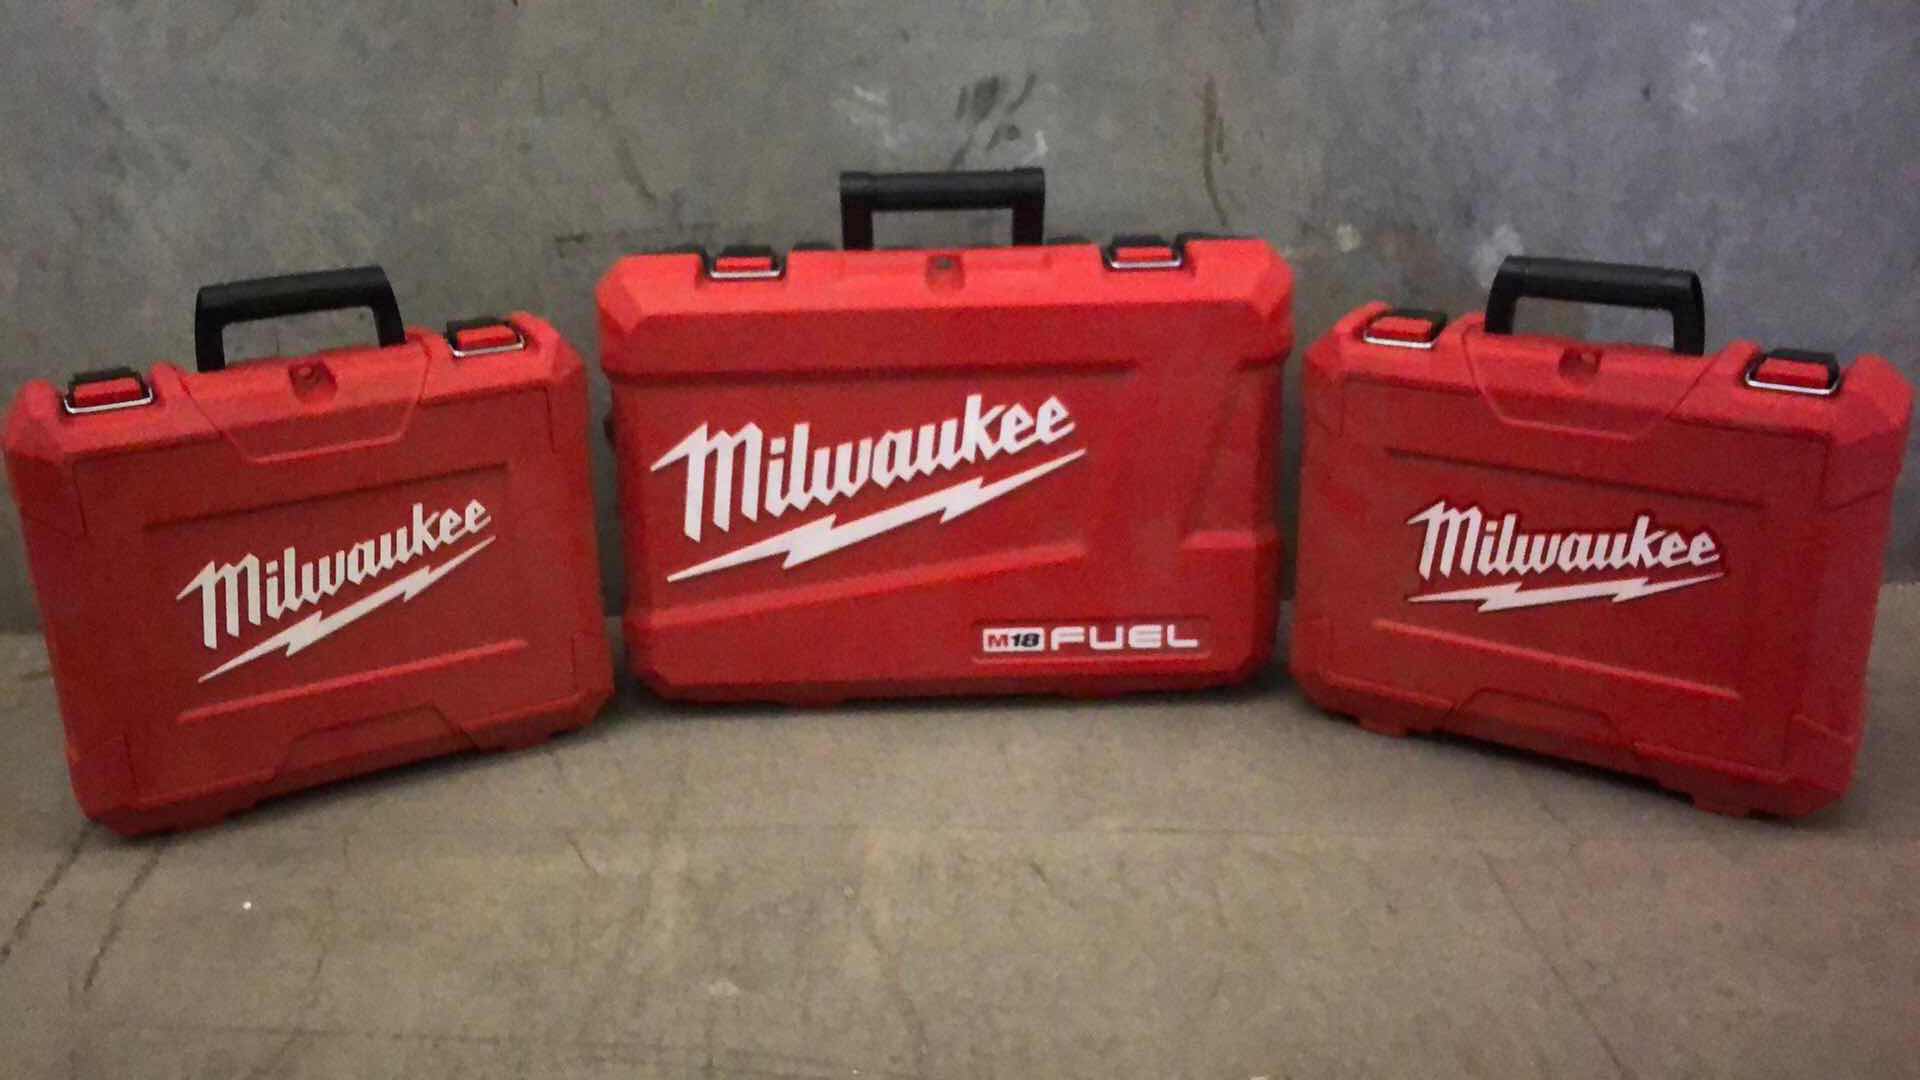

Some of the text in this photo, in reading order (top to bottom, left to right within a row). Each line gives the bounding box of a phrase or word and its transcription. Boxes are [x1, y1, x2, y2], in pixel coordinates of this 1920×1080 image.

[650, 393, 1076, 543] Milwaukee
[176, 499, 492, 649] Milwaukee
[1407, 501, 1721, 580] Milwaukee
[986, 624, 1199, 651] M18 FUEL
